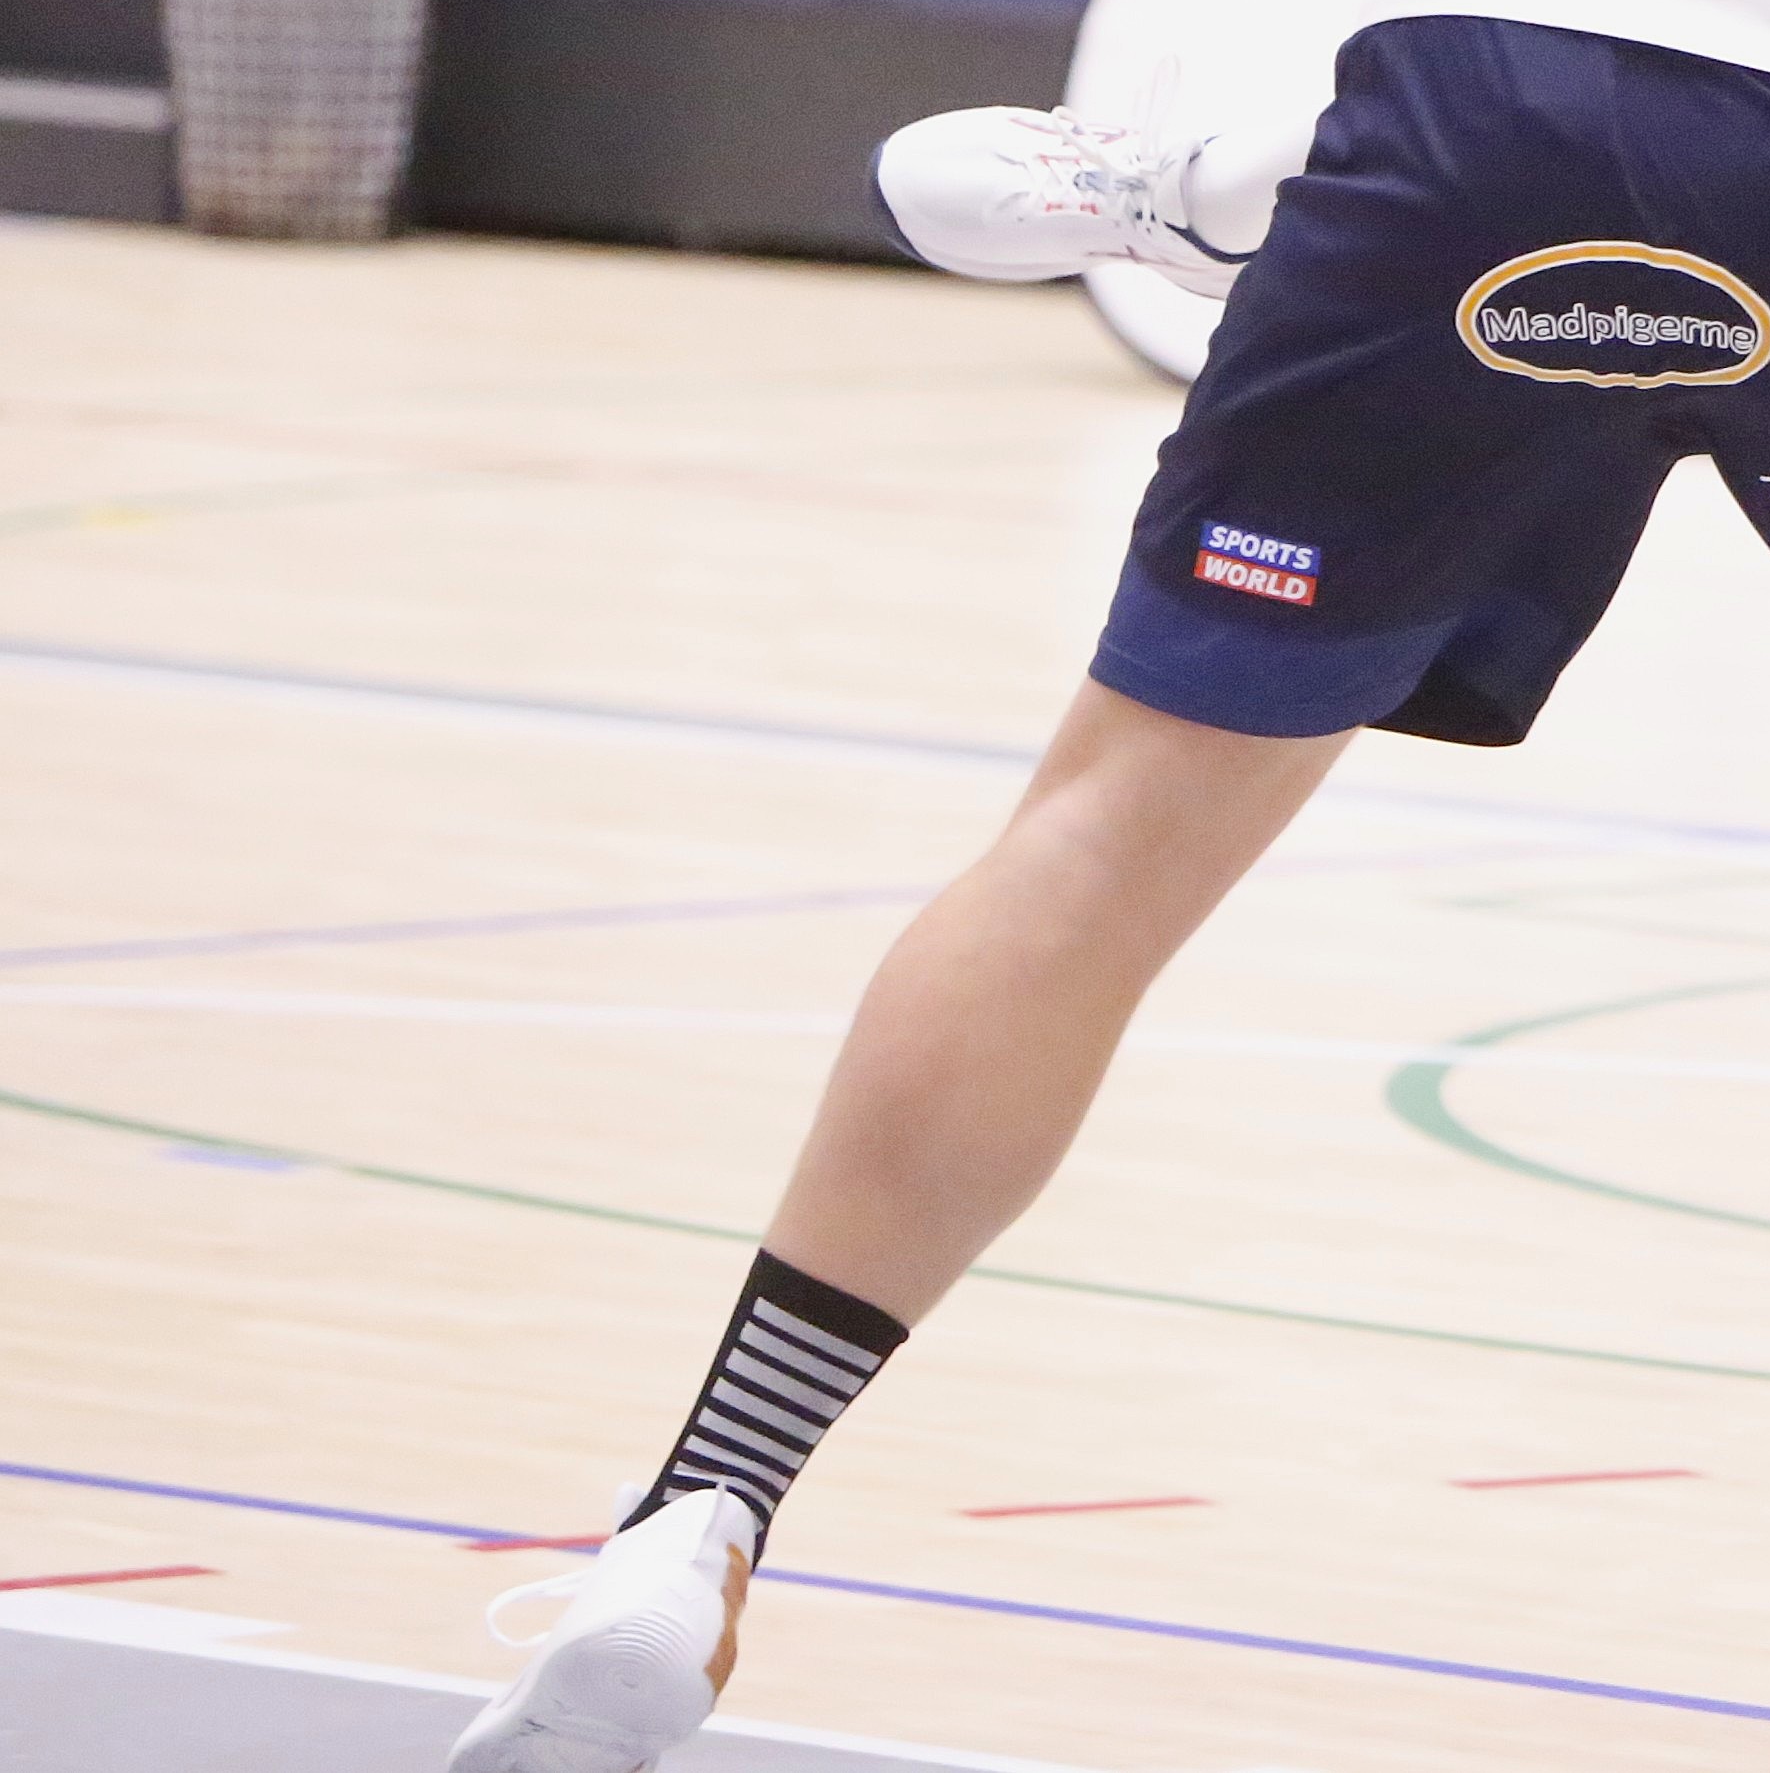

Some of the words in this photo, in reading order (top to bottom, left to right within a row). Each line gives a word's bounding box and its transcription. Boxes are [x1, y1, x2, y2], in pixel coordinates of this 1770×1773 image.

[1480, 302, 1758, 355] Madpigerne
[1207, 525, 1314, 570] SPORTS
[1203, 555, 1309, 600] WORLD
